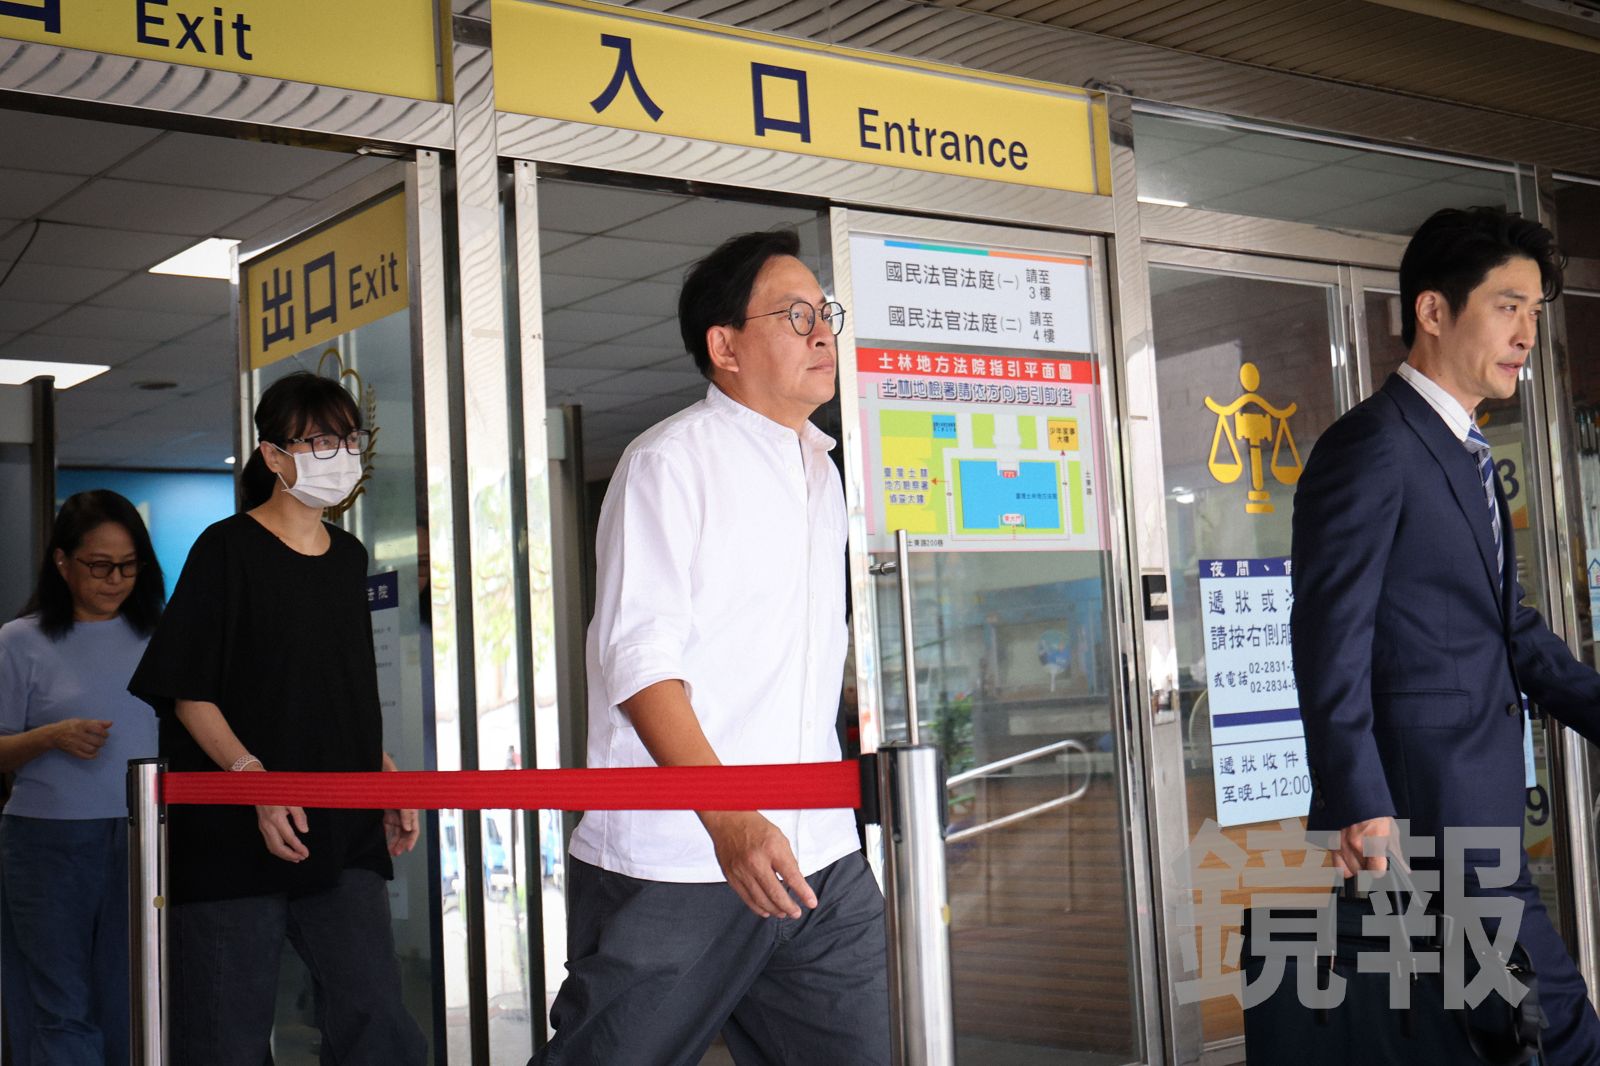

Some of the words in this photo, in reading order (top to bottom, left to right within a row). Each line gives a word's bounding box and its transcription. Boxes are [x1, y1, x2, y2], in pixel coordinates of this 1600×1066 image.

[137, 0, 253, 60] Exit
[589, 33, 812, 144] 入口
[857, 107, 1029, 171] Entrance
[1025, 268, 1050, 285] 請至
[262, 251, 337, 352] 出口
[349, 252, 399, 310] Exit
[1029, 286, 1052, 301] 3樓
[1029, 310, 1054, 327] 請至
[1033, 328, 1056, 344] 4樓
[878, 352, 1073, 380] 士林地方法院指引平面圖
[1214, 671, 1248, 689] 或電話
